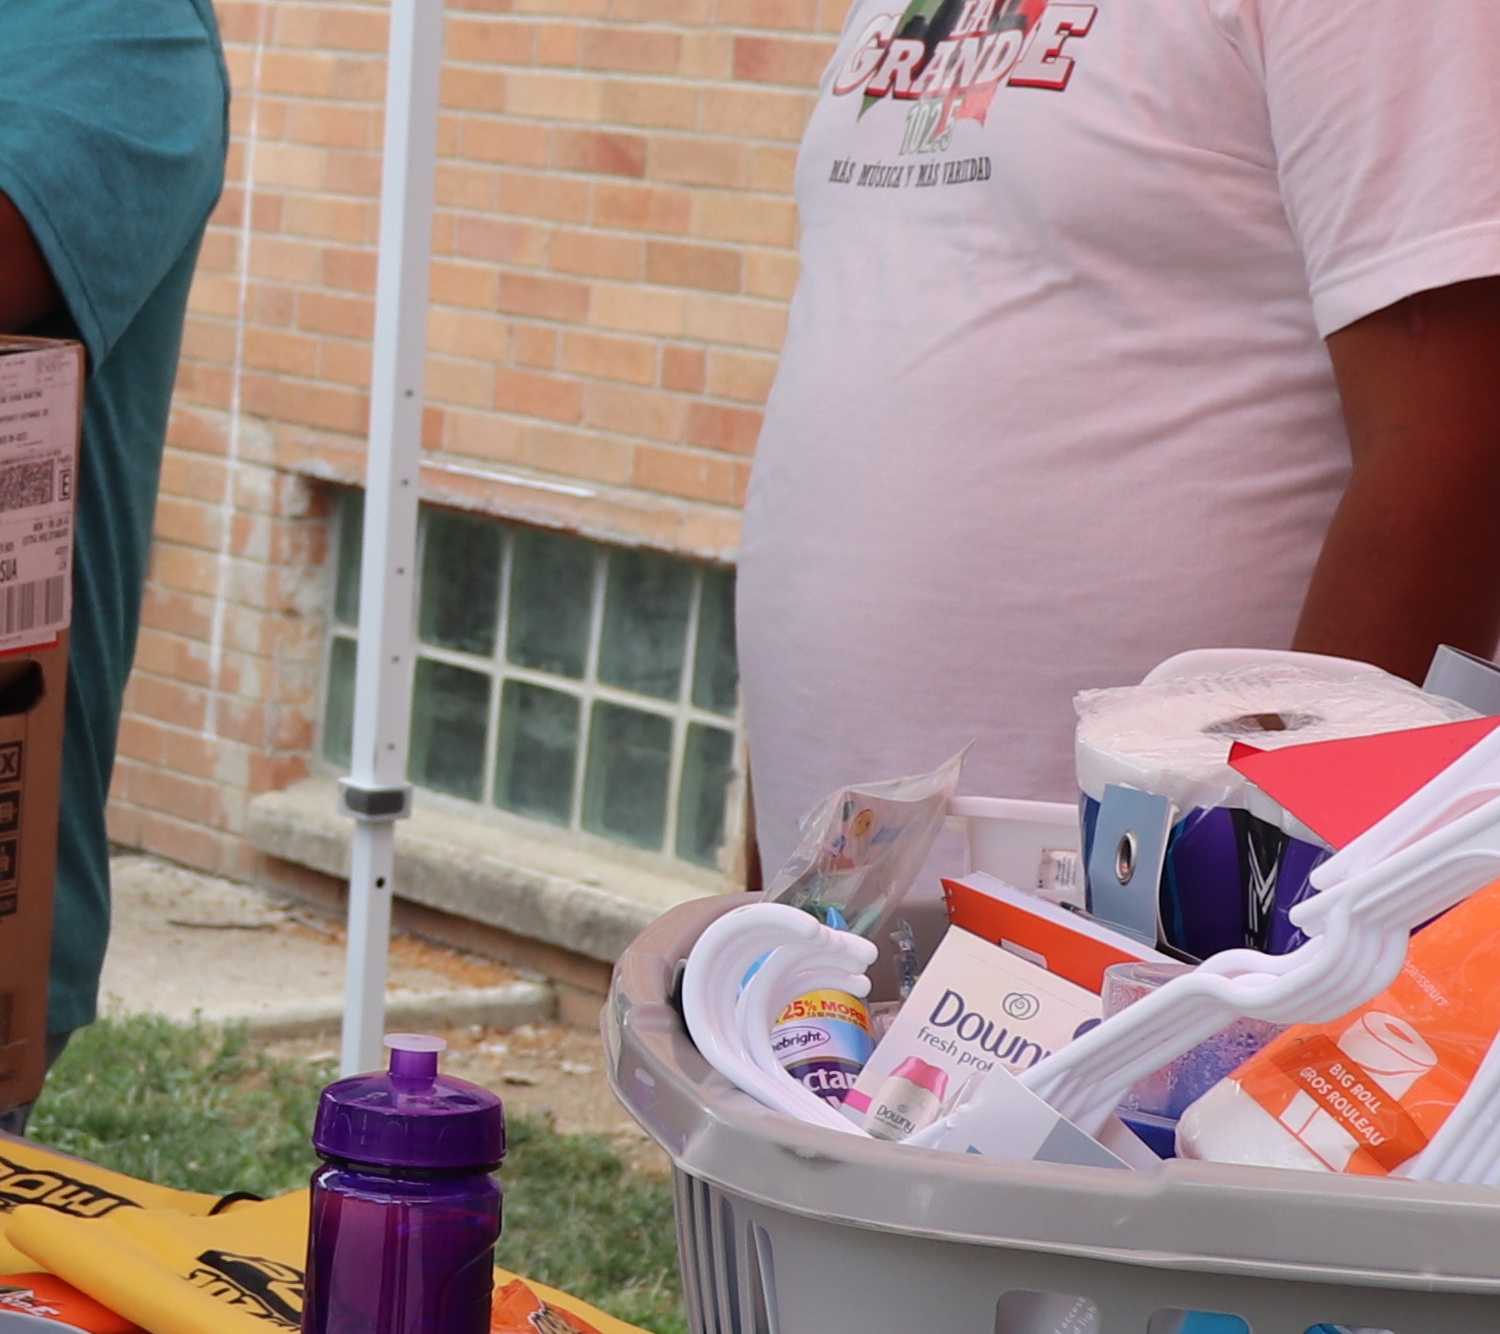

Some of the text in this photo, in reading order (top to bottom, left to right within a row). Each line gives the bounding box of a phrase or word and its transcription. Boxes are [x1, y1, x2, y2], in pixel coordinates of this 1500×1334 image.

[832, 3, 1098, 100] GRANDE
[899, 98, 964, 157] 102.5
[829, 155, 992, 188] MÁS MÚSICA Y MÁS VARIEDAD
[782, 999, 818, 1021] 25%
[820, 999, 868, 1024] MORE
[772, 1030, 822, 1052] ebright
[917, 1025, 958, 1059] fresh
[1328, 1063, 1383, 1115] BIG ROLL
[876, 1104, 916, 1135] Downy
[1300, 1066, 1386, 1148] GROS ROULEAU
[1061, 1297, 1086, 1330] access
[1078, 1305, 1097, 1327] ligh
